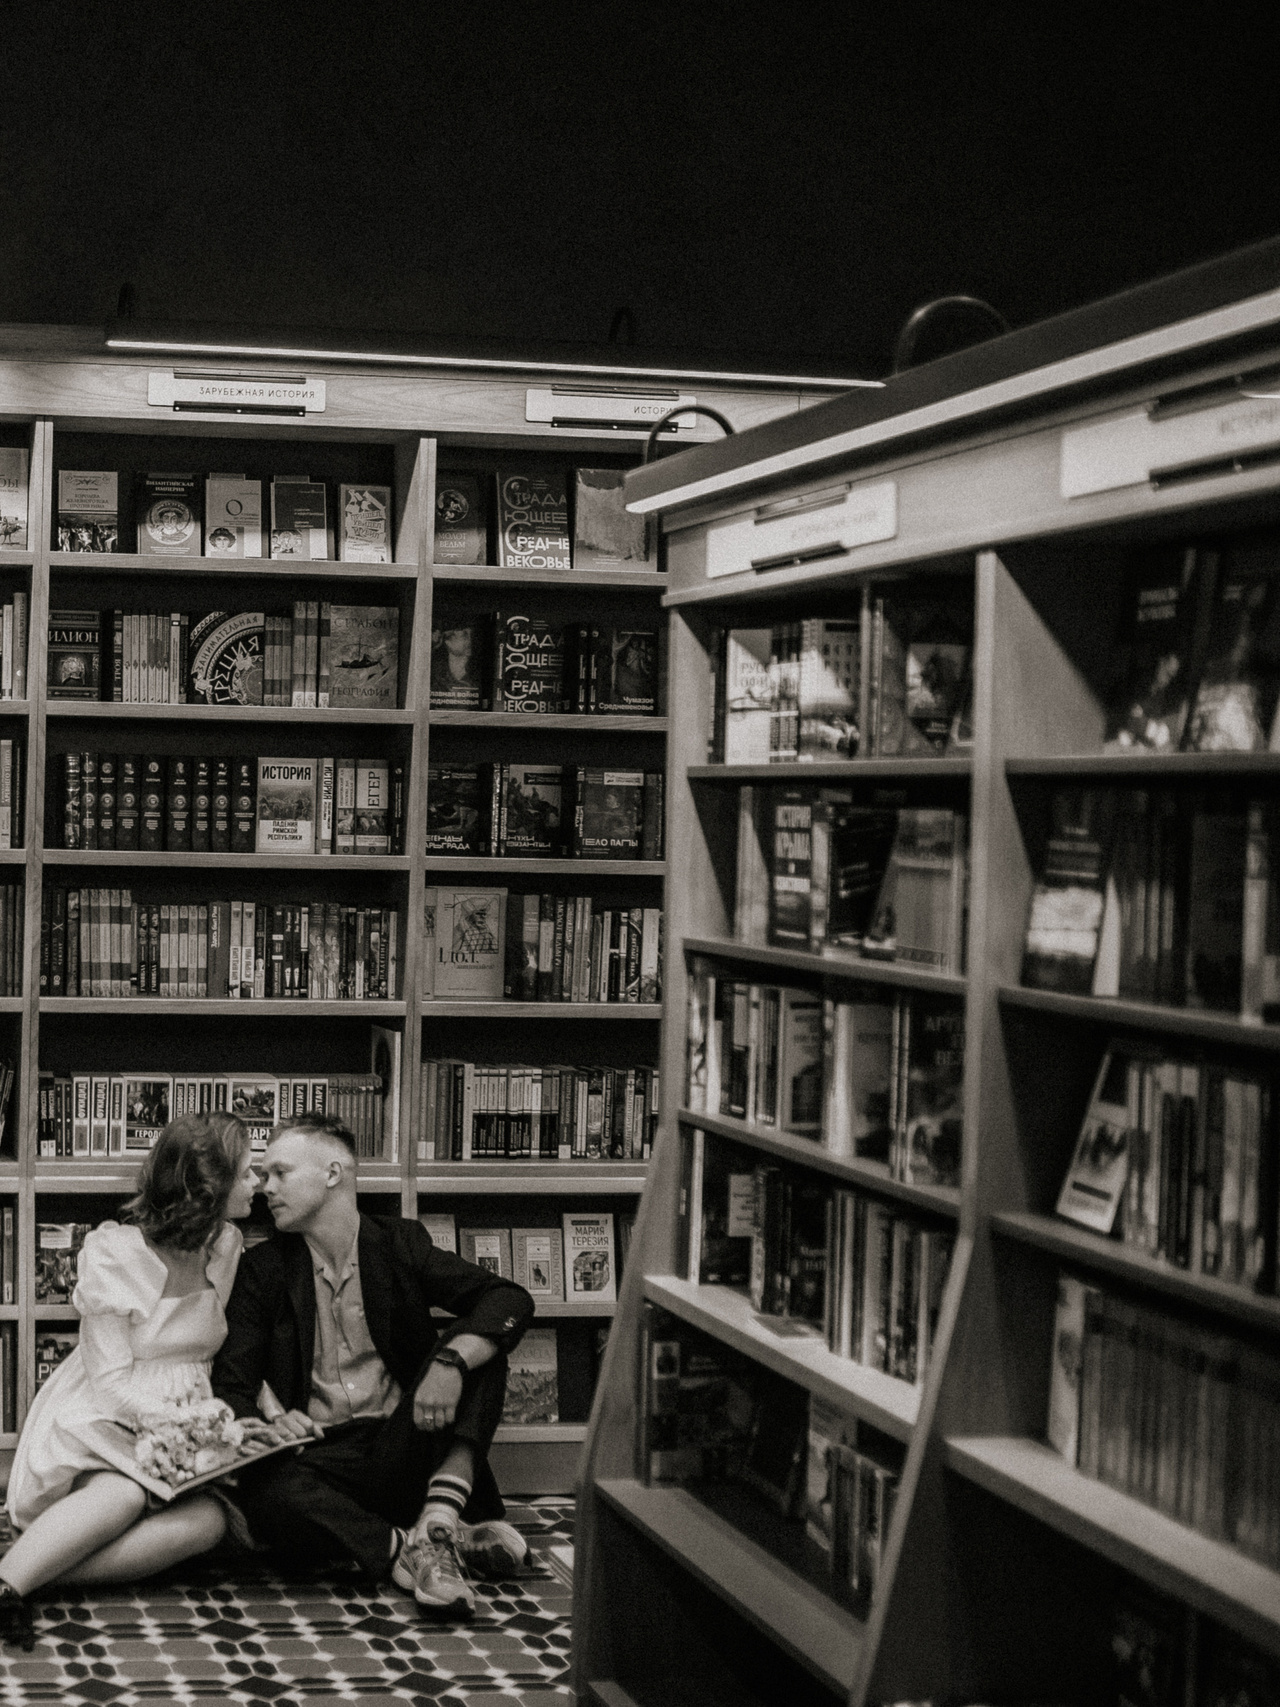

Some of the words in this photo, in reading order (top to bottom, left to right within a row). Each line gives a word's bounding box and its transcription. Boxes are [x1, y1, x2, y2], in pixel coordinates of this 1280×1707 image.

[199, 386, 264, 397] ЗАРУБЕЖНАЯ
[267, 388, 315, 399] ИСТОРИЯ
[438, 532, 467, 540] МОЛОТ
[439, 540, 466, 548] ВЕДЬМ
[506, 555, 570, 568] ВЕКОВЬЕ
[334, 618, 397, 629] СТРАБОН
[48, 630, 99, 643] ИЛИОН
[195, 615, 258, 674] ЗАНИМАТЕЛЬНАЯ
[209, 635, 259, 702] ГРЕЦИЯ
[332, 686, 390, 697] ГЕОГРАФИЯ
[262, 766, 312, 780] ИСТОРИЯ
[323, 766, 332, 800] ИСТОРИЯ
[367, 771, 380, 807] ЕГЕР
[426, 842, 470, 850] АРЬГРАДА
[78, 1083, 87, 1118] ФУКИДИД
[97, 1083, 106, 1118] ФУКИДИД
[315, 1085, 323, 1114] ЛУТАРХ
[575, 1226, 605, 1236] МАРИЯ
[572, 1236, 609, 1246] ТЕРЕЗИЯ
[517, 1235, 525, 1285] RONICON
[552, 1230, 561, 1296] CHRONICON
